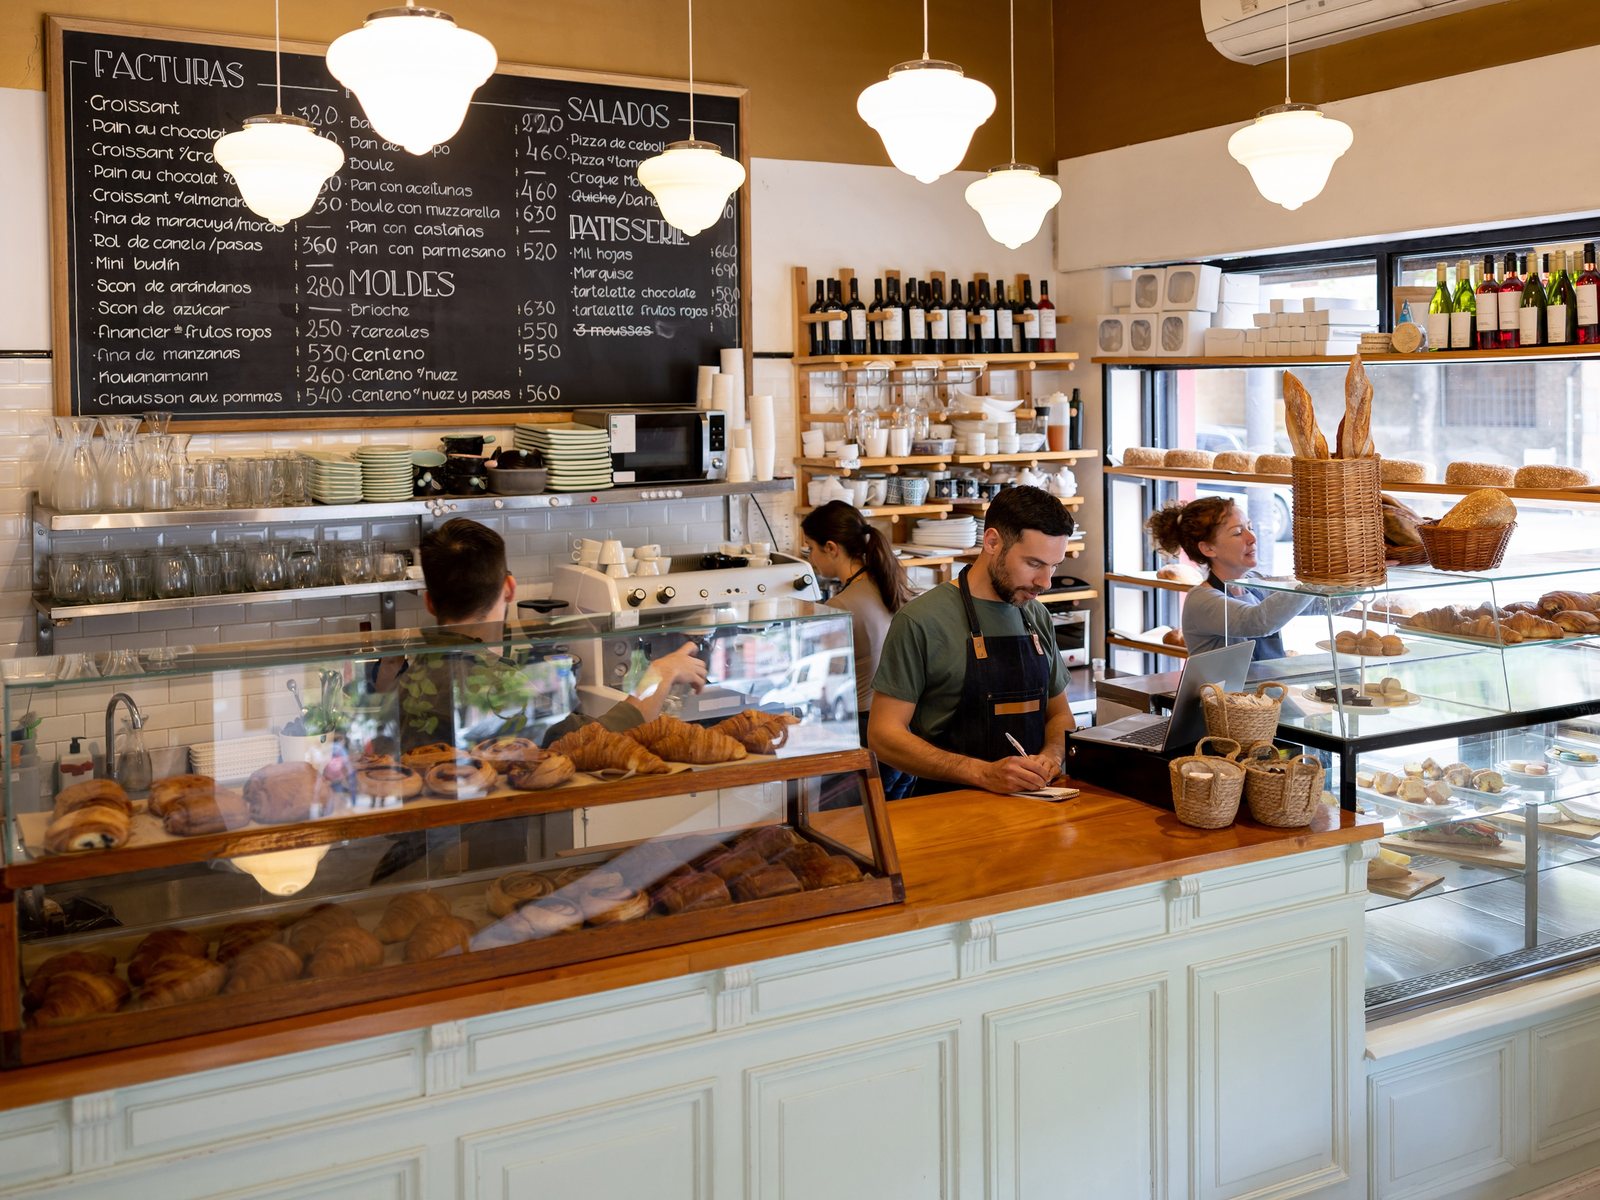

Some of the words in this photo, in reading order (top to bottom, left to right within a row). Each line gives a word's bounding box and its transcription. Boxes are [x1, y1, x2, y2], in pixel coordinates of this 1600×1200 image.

[95, 50, 244, 88] FACTURAS
[90, 95, 180, 114] Croissant
[568, 97, 669, 128] SALADOS
[93, 119, 130, 134] Pain
[135, 125, 155, 135] au
[160, 124, 227, 140] chocolat
[523, 114, 563, 134] 220
[350, 136, 377, 149] Pan
[527, 136, 567, 160] 460
[571, 133, 606, 147] Pizza
[610, 138, 626, 148] de
[92, 142, 173, 159] Croissant
[571, 153, 604, 166] Pizza
[349, 157, 394, 171] Boule
[95, 165, 127, 178] Pain
[132, 170, 150, 180] au
[157, 170, 218, 184] chocolat
[571, 172, 618, 188] Croque
[93, 188, 170, 204] Croissant
[351, 179, 376, 191] Pan
[380, 183, 402, 193] con
[406, 182, 472, 197] aceitunas
[521, 179, 556, 202] 460
[131, 213, 151, 225] de
[351, 199, 394, 213] Boule
[398, 204, 421, 214] con
[426, 206, 500, 218] muzzarella
[524, 205, 556, 223] 630
[350, 220, 376, 233] Pan
[383, 224, 406, 233] con
[569, 214, 690, 246] PATISSERIE
[93, 234, 120, 247] Rol
[128, 235, 149, 249] de
[153, 238, 205, 250] canela
[302, 236, 337, 255] 360
[350, 241, 377, 254] Pan
[389, 245, 413, 255] con
[423, 246, 506, 259] parmesano
[524, 242, 557, 261] 520
[97, 256, 123, 269] Mini
[134, 257, 179, 271] budín
[574, 247, 591, 259] Mil
[597, 248, 633, 264] hojas
[349, 270, 455, 297] MOLDES
[574, 267, 633, 282] Marquise
[97, 279, 135, 292] Scon
[145, 280, 164, 292] de
[170, 281, 251, 293] arándanos
[307, 276, 344, 298] 280
[573, 285, 635, 298] tartelette
[641, 287, 696, 298] chocolate
[98, 301, 137, 314] Scon
[143, 301, 165, 315] de
[173, 304, 230, 315] azúcar
[351, 303, 409, 316] Brioche
[524, 300, 555, 316] 630
[641, 305, 676, 316] frutos
[680, 307, 708, 319] rojos
[185, 325, 232, 338] frutos
[236, 328, 271, 341] rojos
[306, 319, 341, 338] 250
[523, 322, 557, 340] 550
[136, 349, 155, 361] de
[164, 349, 240, 360] manzanas
[309, 344, 349, 362] 530
[352, 347, 424, 362] Centeno
[524, 344, 560, 361] 550
[306, 365, 344, 384] 260
[353, 368, 412, 381] Centeno
[99, 394, 184, 405] Chausson
[190, 394, 218, 403] aux
[223, 393, 282, 406] pommes
[306, 386, 342, 406] 540
[352, 389, 411, 402] Centeno
[458, 391, 467, 403] y
[472, 390, 510, 404] pasas
[527, 385, 560, 402] 560
